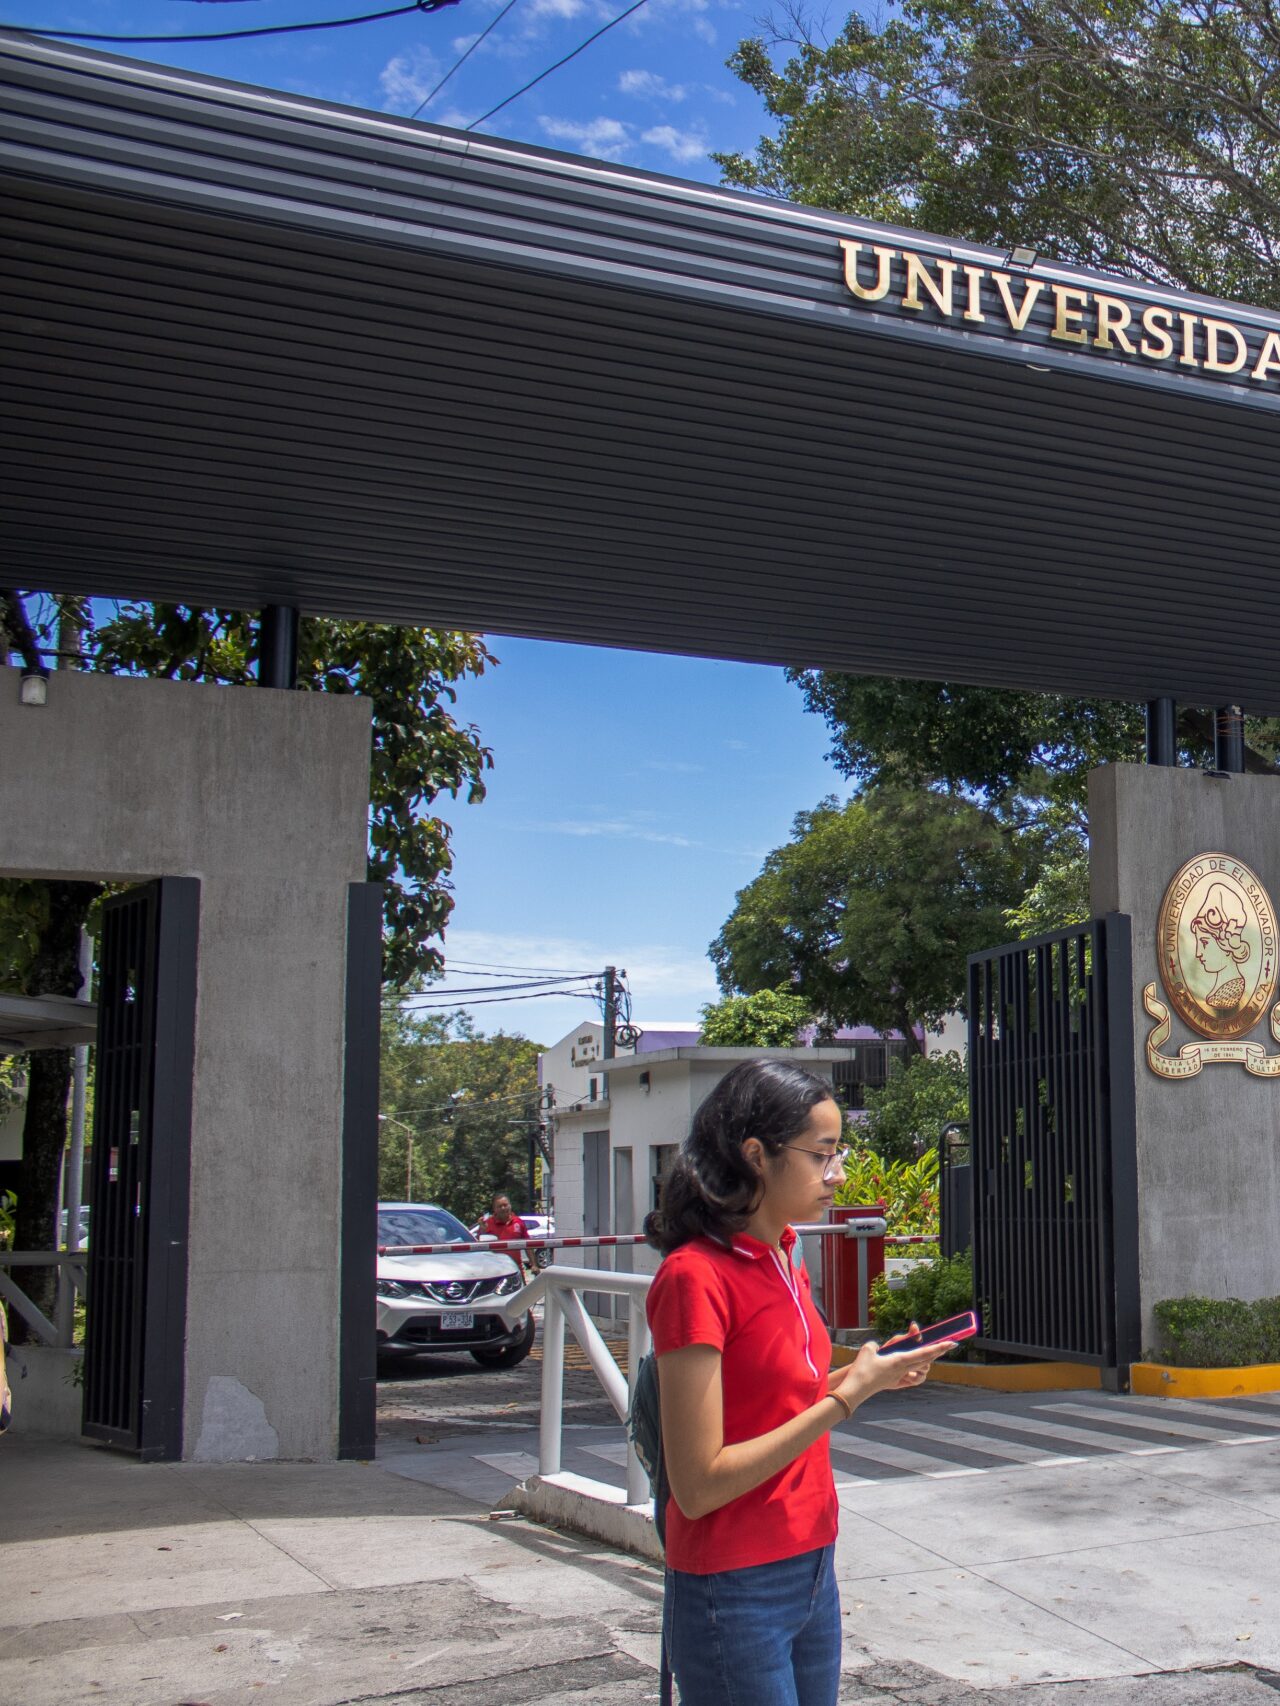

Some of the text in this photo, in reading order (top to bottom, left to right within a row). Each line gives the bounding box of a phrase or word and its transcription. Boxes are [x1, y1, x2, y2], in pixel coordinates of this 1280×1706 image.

[1166, 860, 1274, 956] UNIVERSIDAD DE EL SALVADOR
[1155, 1057, 1196, 1066] HACIA LA
[1155, 1063, 1198, 1074] LIBERTAD
